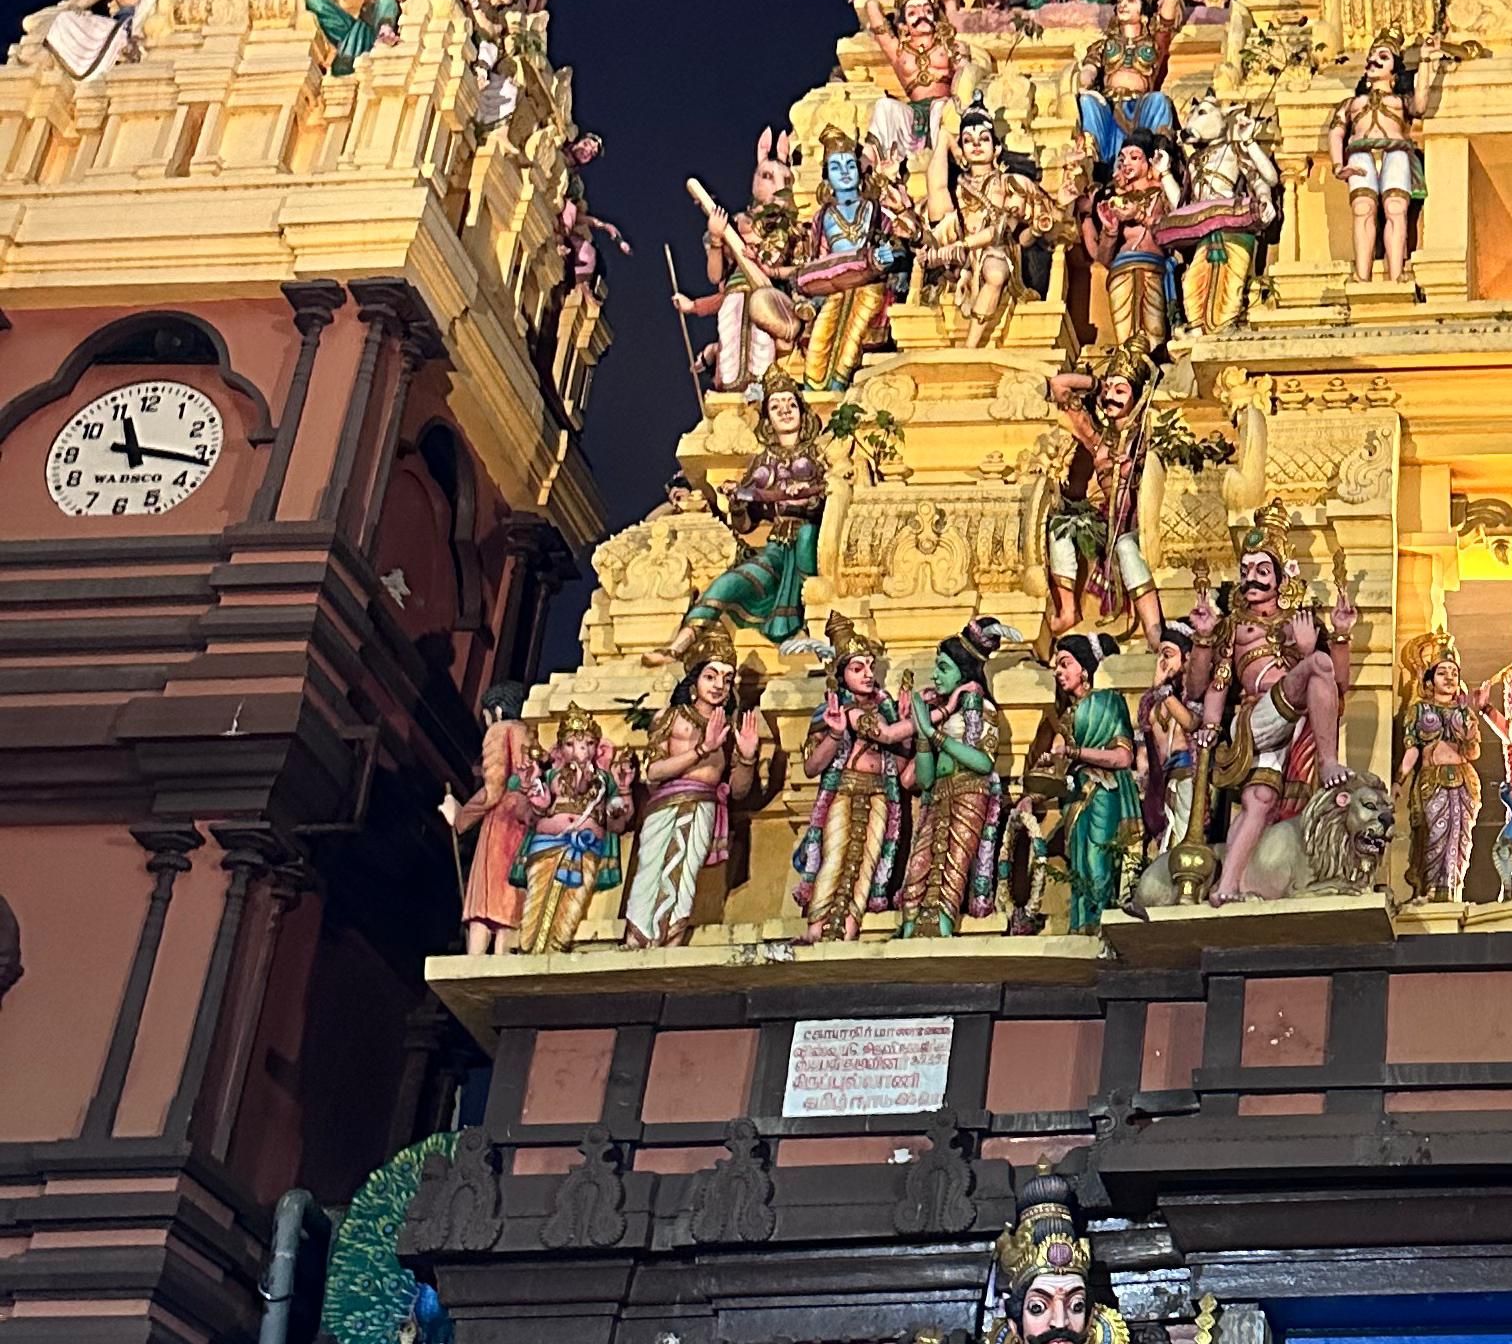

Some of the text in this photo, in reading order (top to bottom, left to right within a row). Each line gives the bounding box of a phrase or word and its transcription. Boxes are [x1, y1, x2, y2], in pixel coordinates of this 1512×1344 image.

[113, 404, 128, 421] 11
[140, 395, 161, 414] 12
[178, 403, 186, 420] 1
[82, 422, 104, 441] 10
[189, 421, 205, 438] 2
[63, 446, 80, 464] 9
[194, 444, 209, 462] 3
[66, 470, 83, 488] 8
[94, 473, 163, 484] WADSCO
[173, 471, 188, 487] 4
[85, 491, 101, 509] 7
[112, 497, 129, 515] 6
[144, 489, 162, 508] 5
